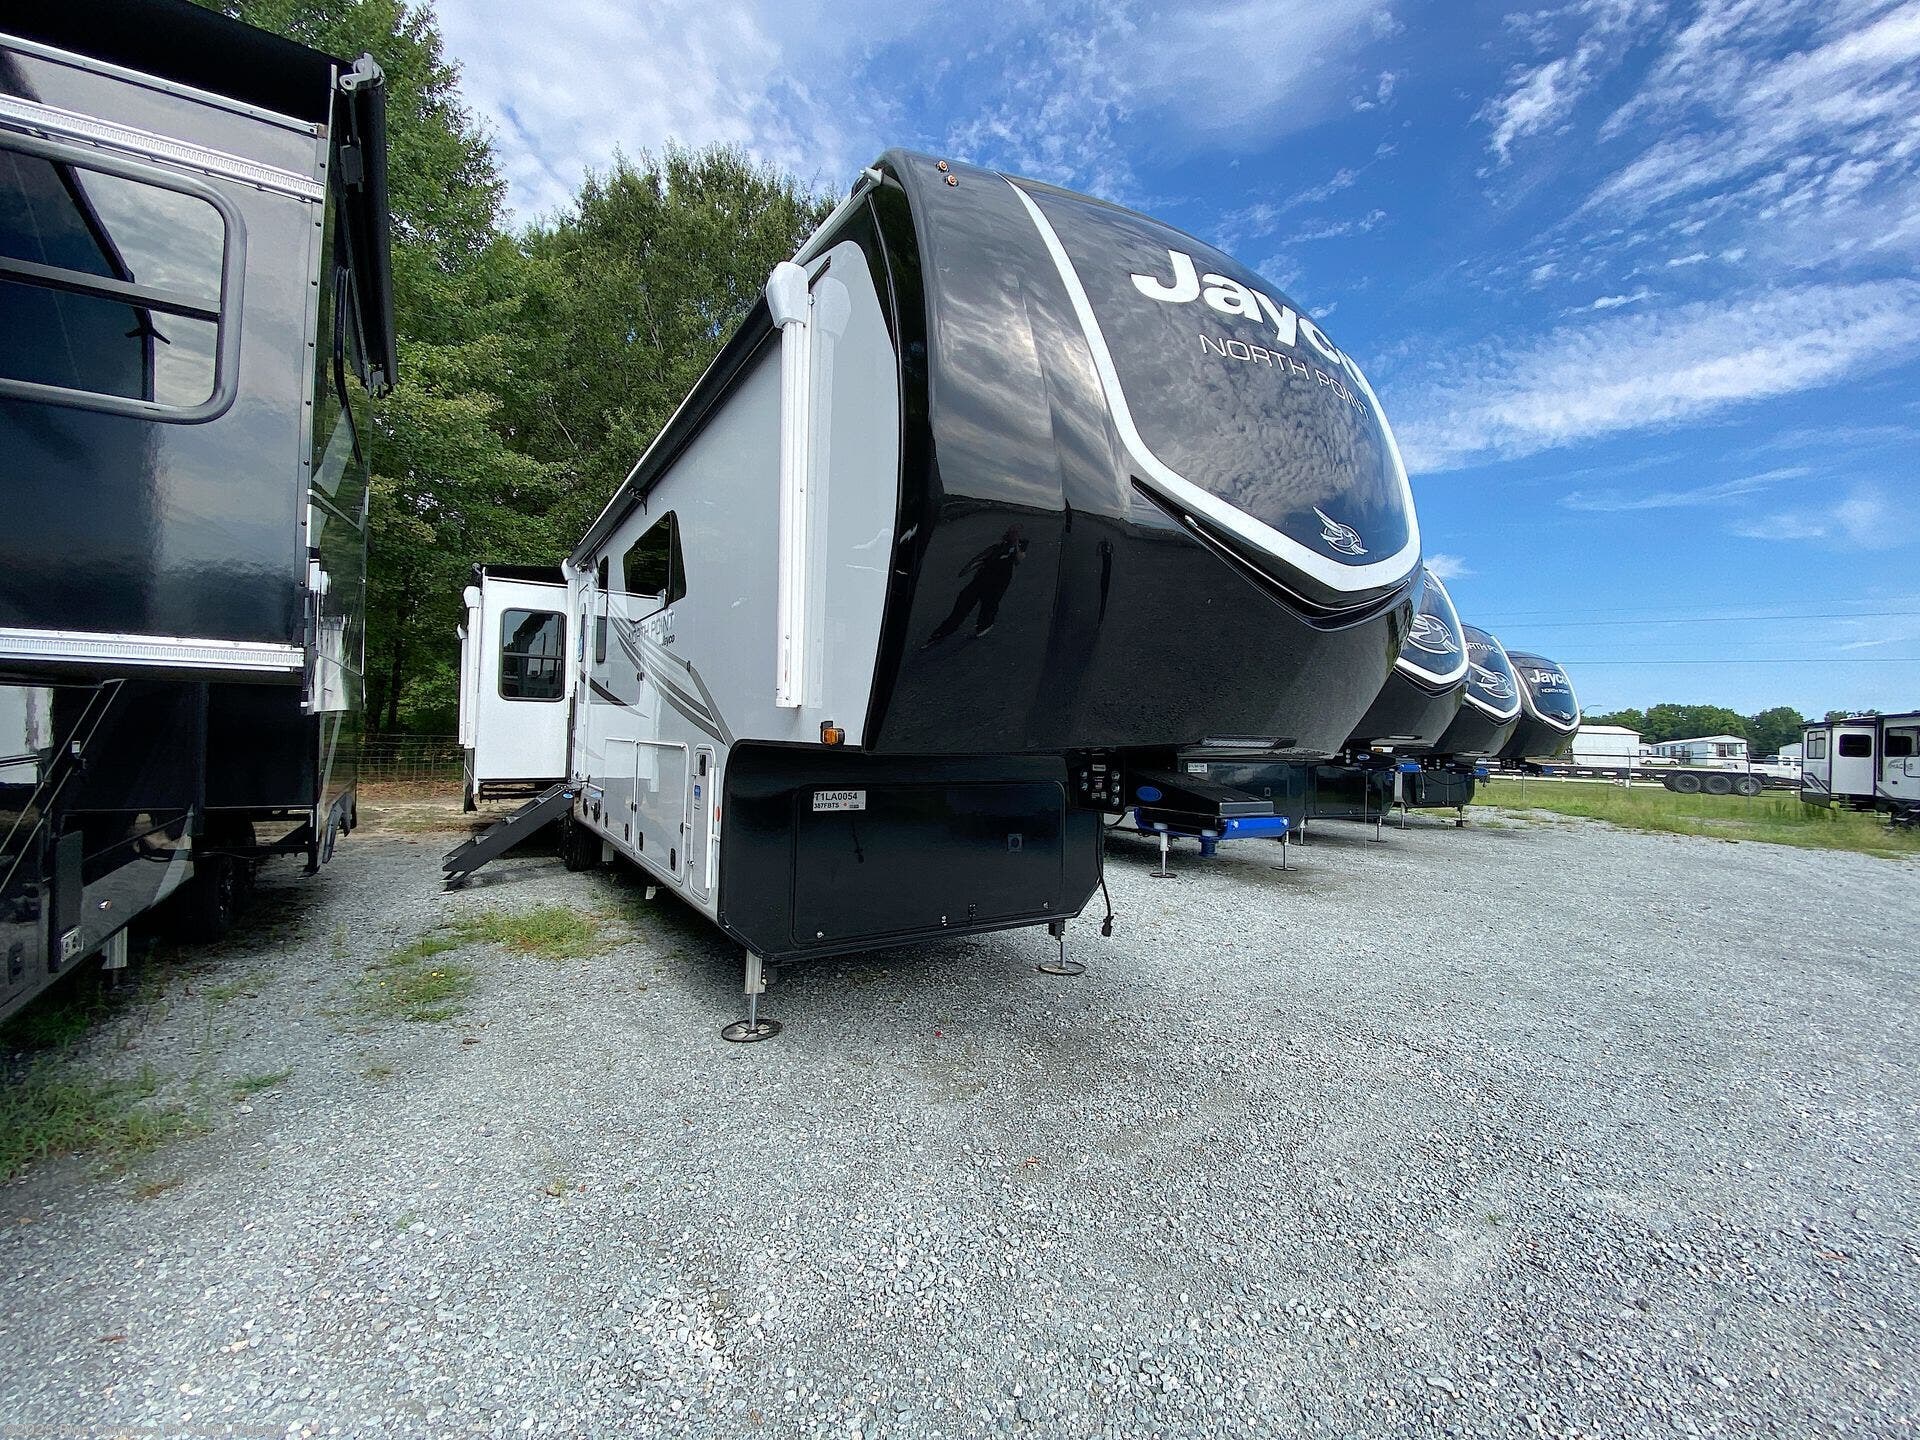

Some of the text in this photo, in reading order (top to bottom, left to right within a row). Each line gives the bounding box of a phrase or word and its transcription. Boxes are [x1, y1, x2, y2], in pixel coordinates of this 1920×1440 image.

[1199, 334, 1369, 420] NORTH POINT
[814, 792, 858, 801] T1LA0054
